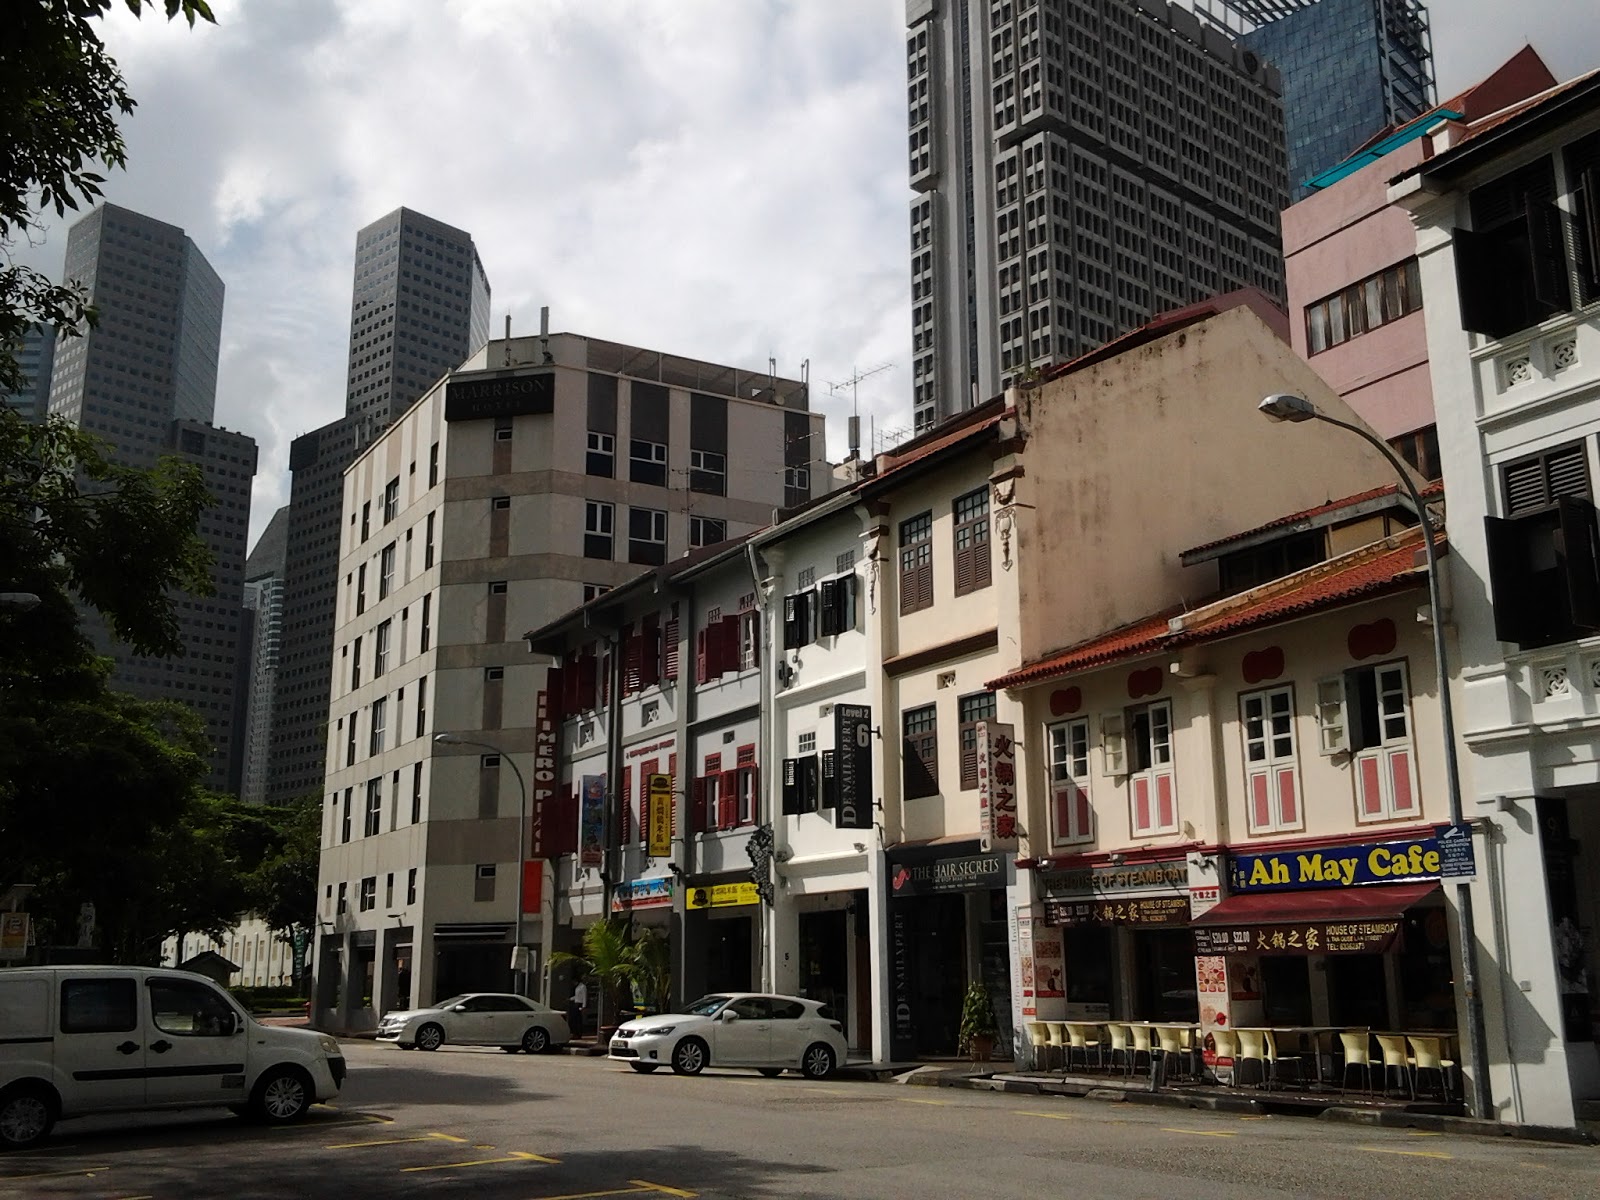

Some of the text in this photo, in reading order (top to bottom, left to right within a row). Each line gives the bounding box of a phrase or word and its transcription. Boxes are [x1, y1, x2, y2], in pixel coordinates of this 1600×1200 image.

[842, 707, 869, 718] Level 2
[857, 723, 869, 748] 6
[912, 865, 931, 880] THE
[934, 863, 956, 878] HAIR
[959, 858, 999, 875] SECRETS
[1249, 857, 1291, 886] Ah
[1297, 853, 1358, 886] May
[1368, 845, 1440, 877] Cafe
[1102, 872, 1117, 888] OF
[1117, 867, 1189, 887] STEAMBOAT
[1326, 922, 1398, 936] HOUSE OF STEAMBOAT
[1327, 943, 1339, 951] TEL:
